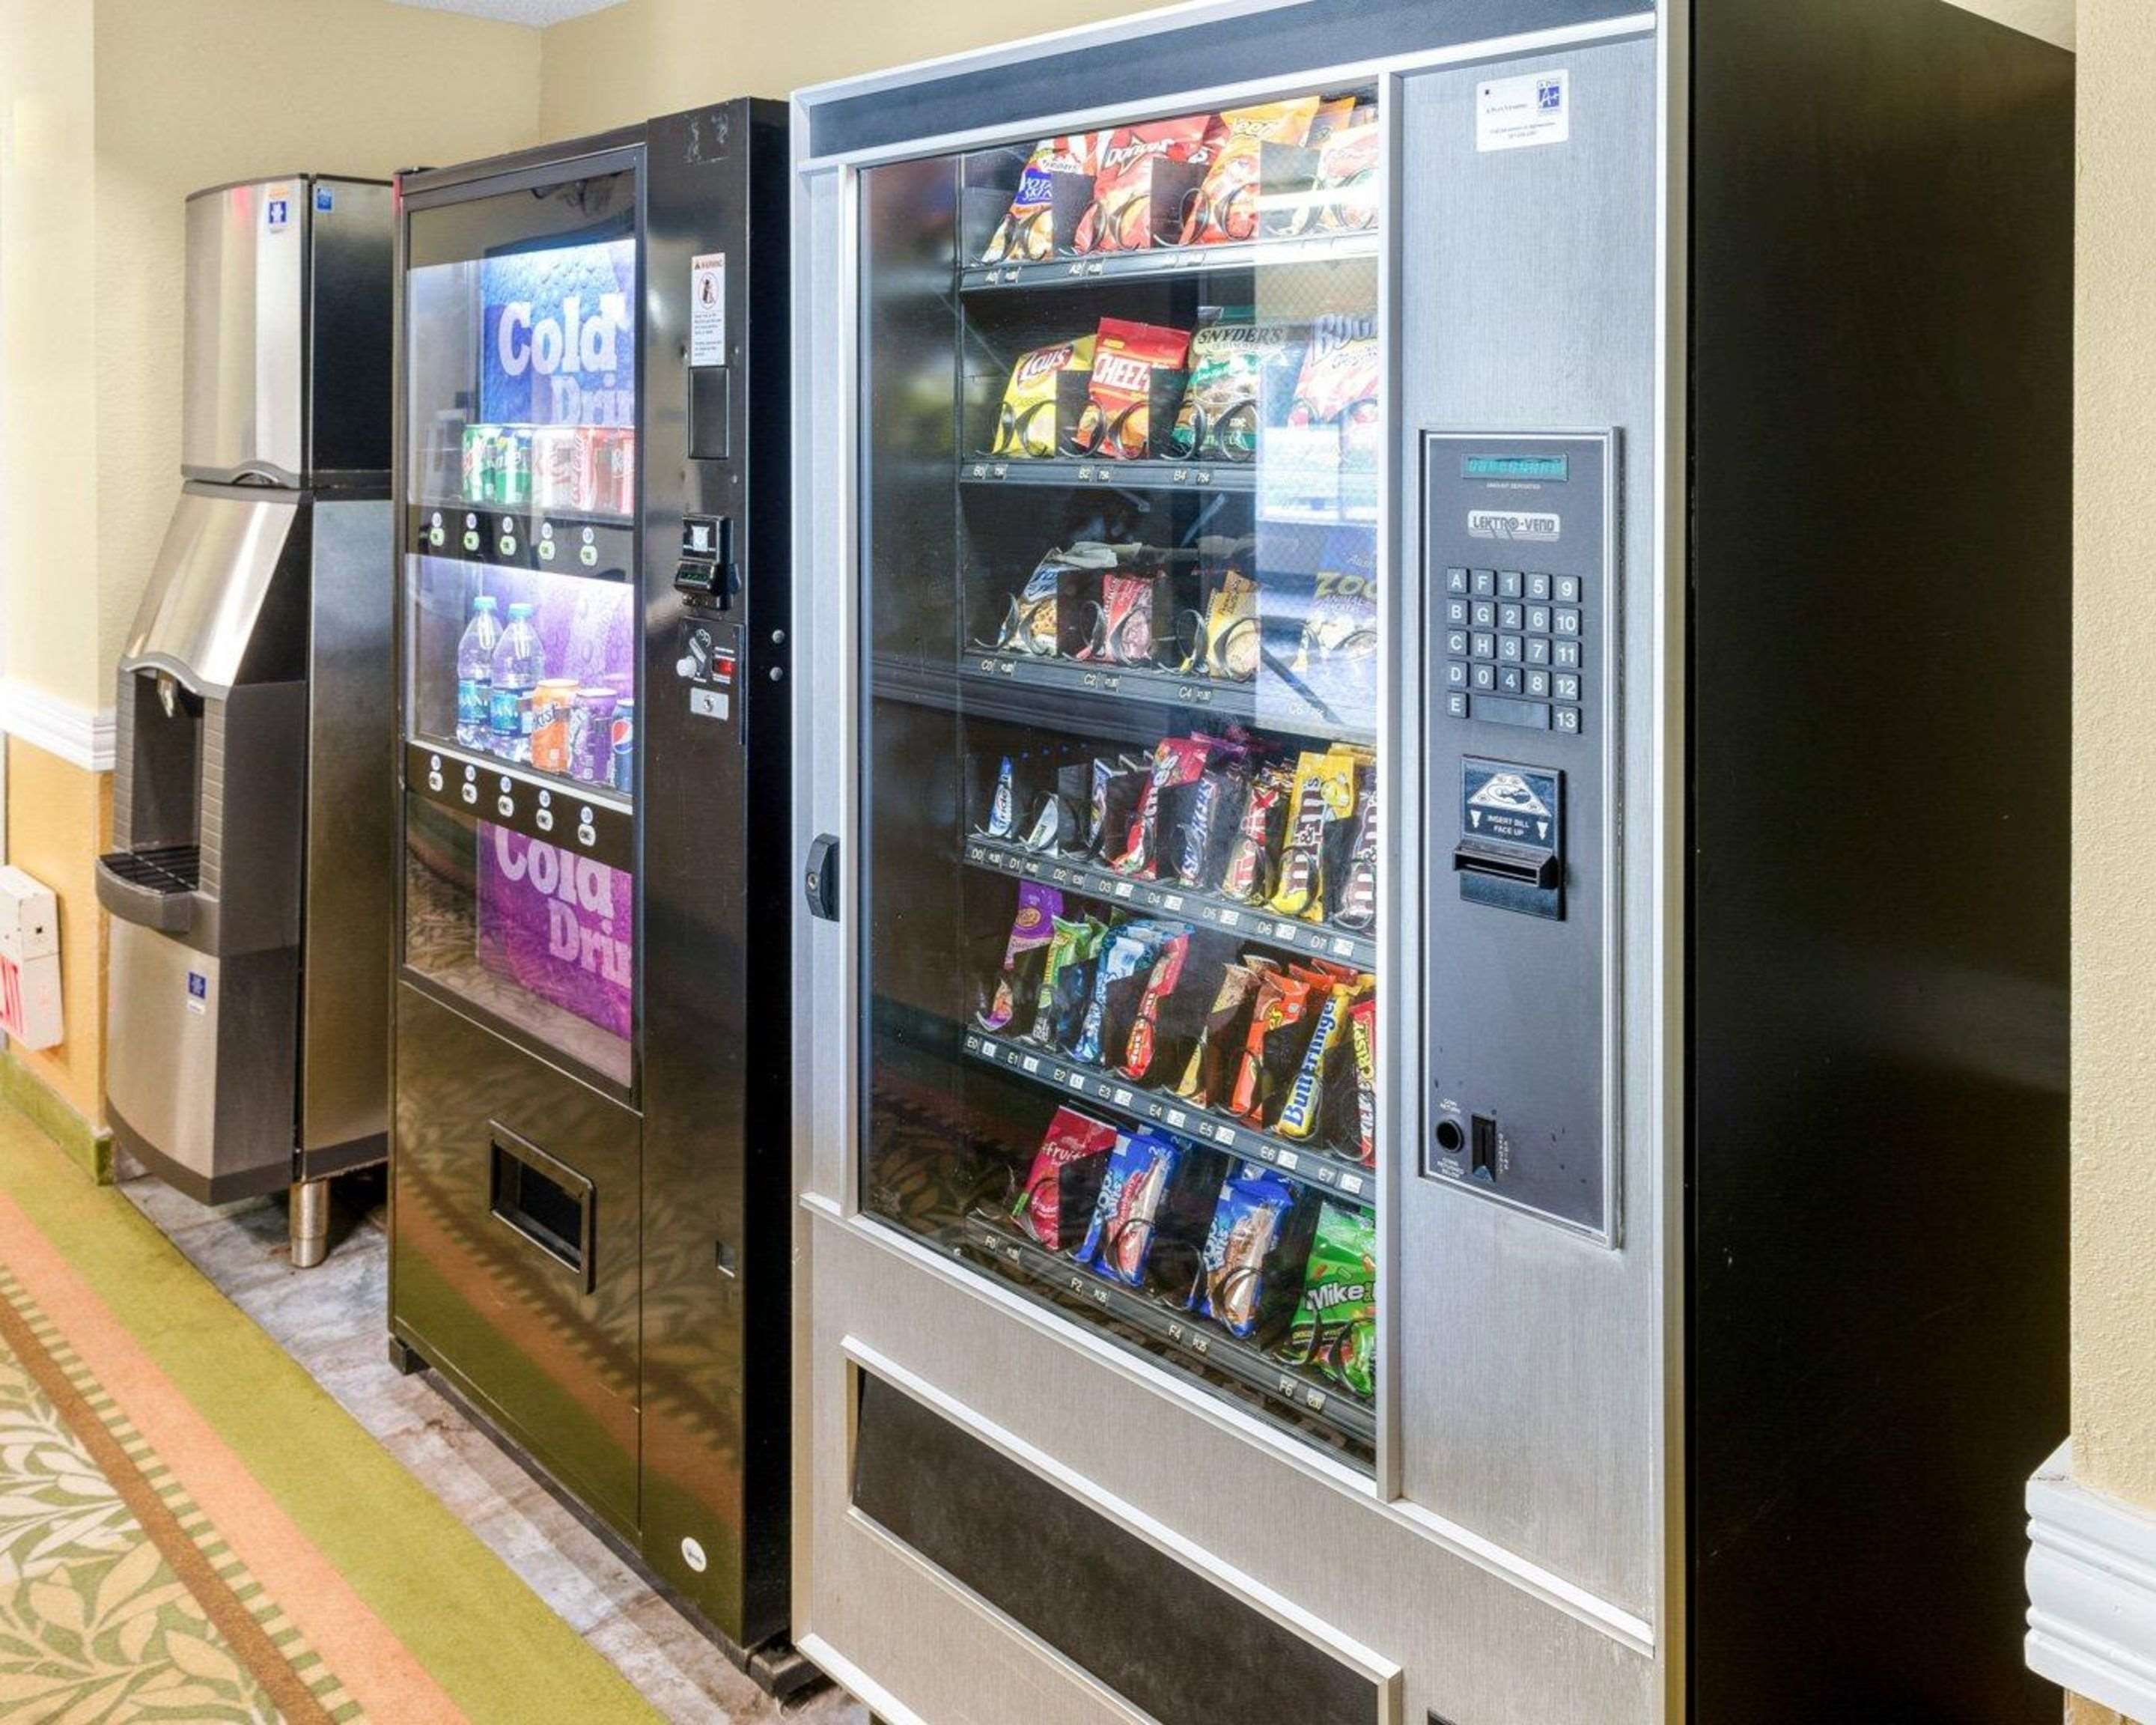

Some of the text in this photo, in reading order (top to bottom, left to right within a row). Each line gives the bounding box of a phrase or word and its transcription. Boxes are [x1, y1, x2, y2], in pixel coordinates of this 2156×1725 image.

[498, 293, 626, 376] Cold
[1451, 574, 1572, 597] A F 1 5 9
[1452, 604, 1576, 631] B G 2 6 10
[1450, 635, 1574, 663] C H 3 7 11
[1451, 666, 1461, 681] D
[1505, 673, 1515, 688] 4
[1532, 676, 1542, 691] 8
[1558, 679, 1576, 696] 12
[1178, 687, 1192, 699] C4
[1451, 697, 1576, 728] E 13
[1493, 825, 1512, 835] FACE
[494, 824, 615, 917] Cold
[1099, 880, 1112, 892] D3
[1148, 892, 1160, 904] D4
[1258, 921, 1272, 934] D6
[1311, 936, 1326, 949] D7
[1008, 1051, 1018, 1064] E1
[1284, 995, 1337, 1127] Butterfinger
[1053, 1068, 1066, 1081] E2
[1098, 1085, 1111, 1098] E3
[1149, 1104, 1161, 1116] E4
[1199, 1123, 1213, 1135] E5
[1260, 1147, 1275, 1160] E6
[1318, 1167, 1335, 1181] E7
[1071, 1277, 1083, 1292] F2
[1306, 1282, 1365, 1311] Mike
[1169, 1324, 1182, 1340] F4
[1279, 1378, 1295, 1397] F6
